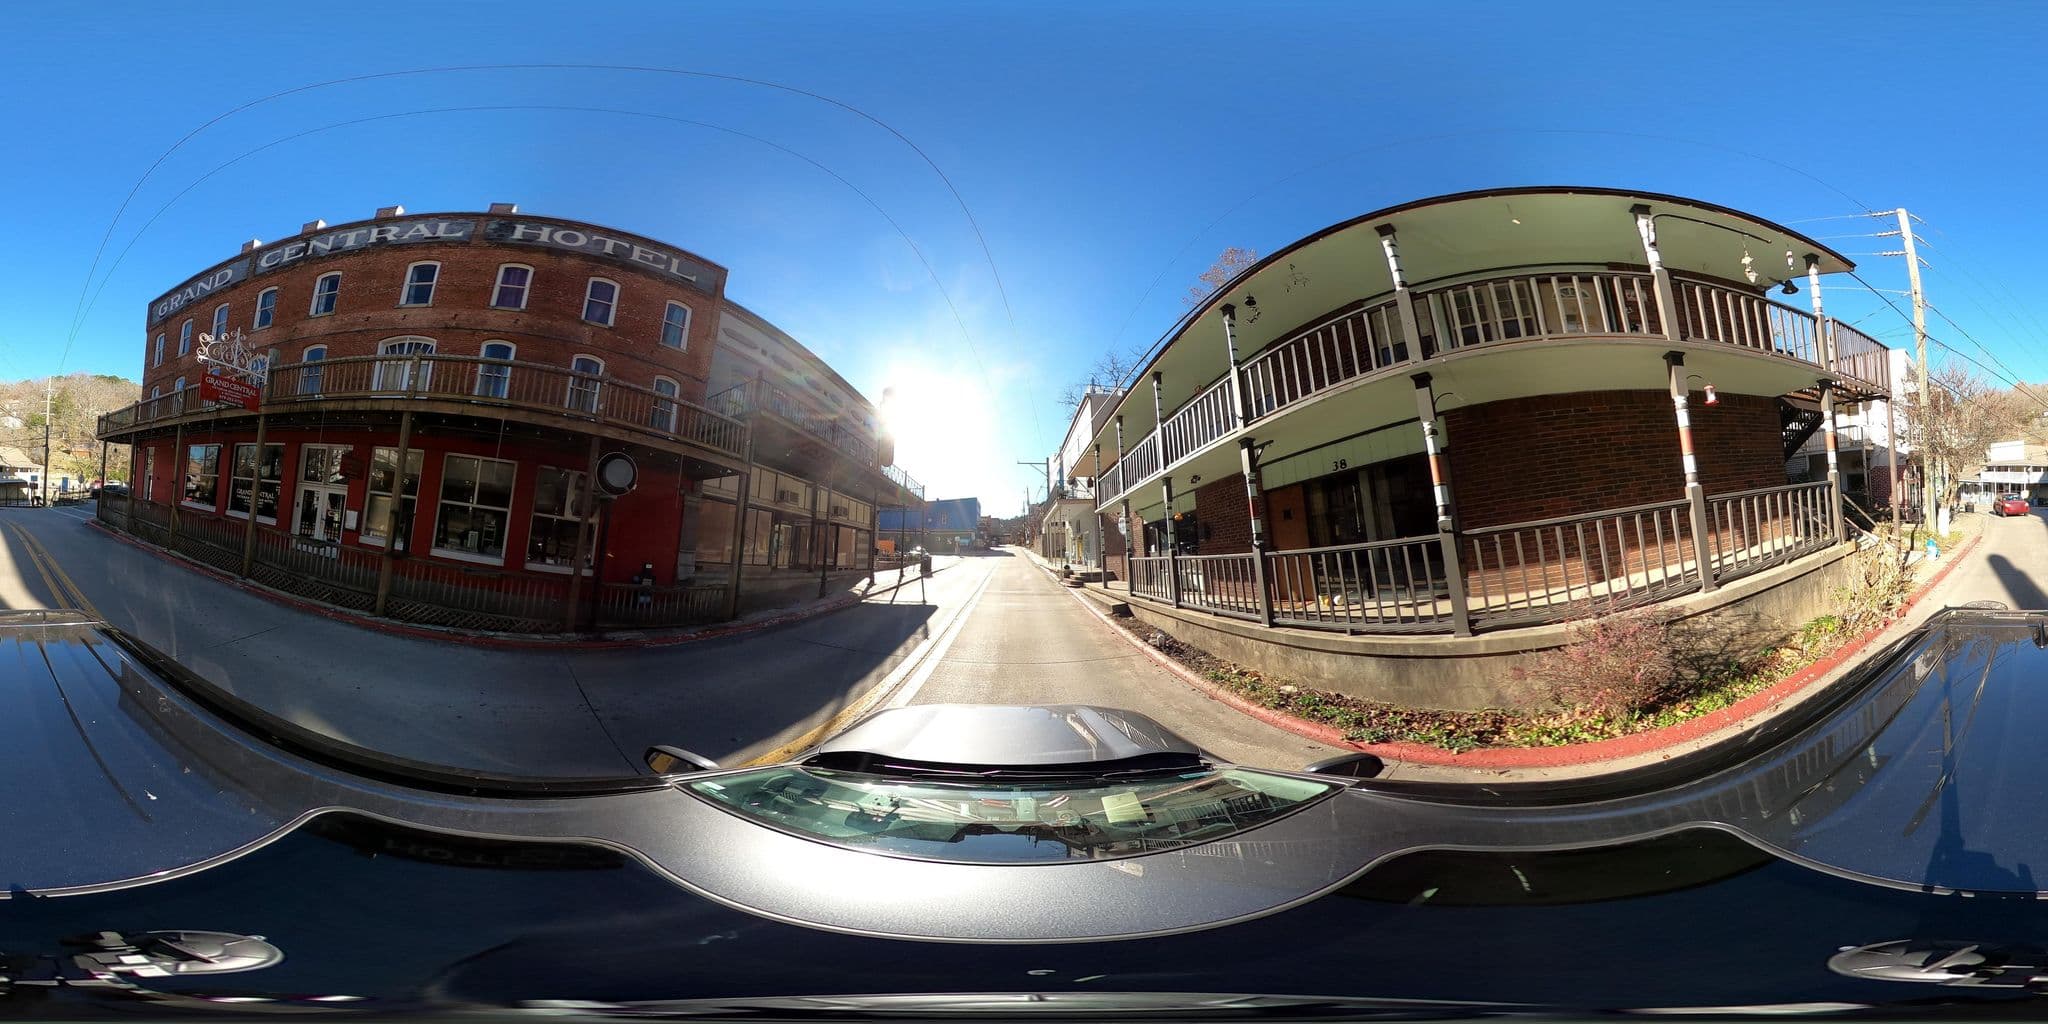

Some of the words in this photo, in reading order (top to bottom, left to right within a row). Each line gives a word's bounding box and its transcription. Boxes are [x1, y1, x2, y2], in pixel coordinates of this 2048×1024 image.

[158, 268, 233, 317] GRAND
[260, 222, 465, 269] CENTRAL
[509, 224, 697, 283] HOTEL
[205, 376, 230, 388] GRAND
[230, 383, 257, 397] CENTRAL
[1333, 459, 1347, 471] 38
